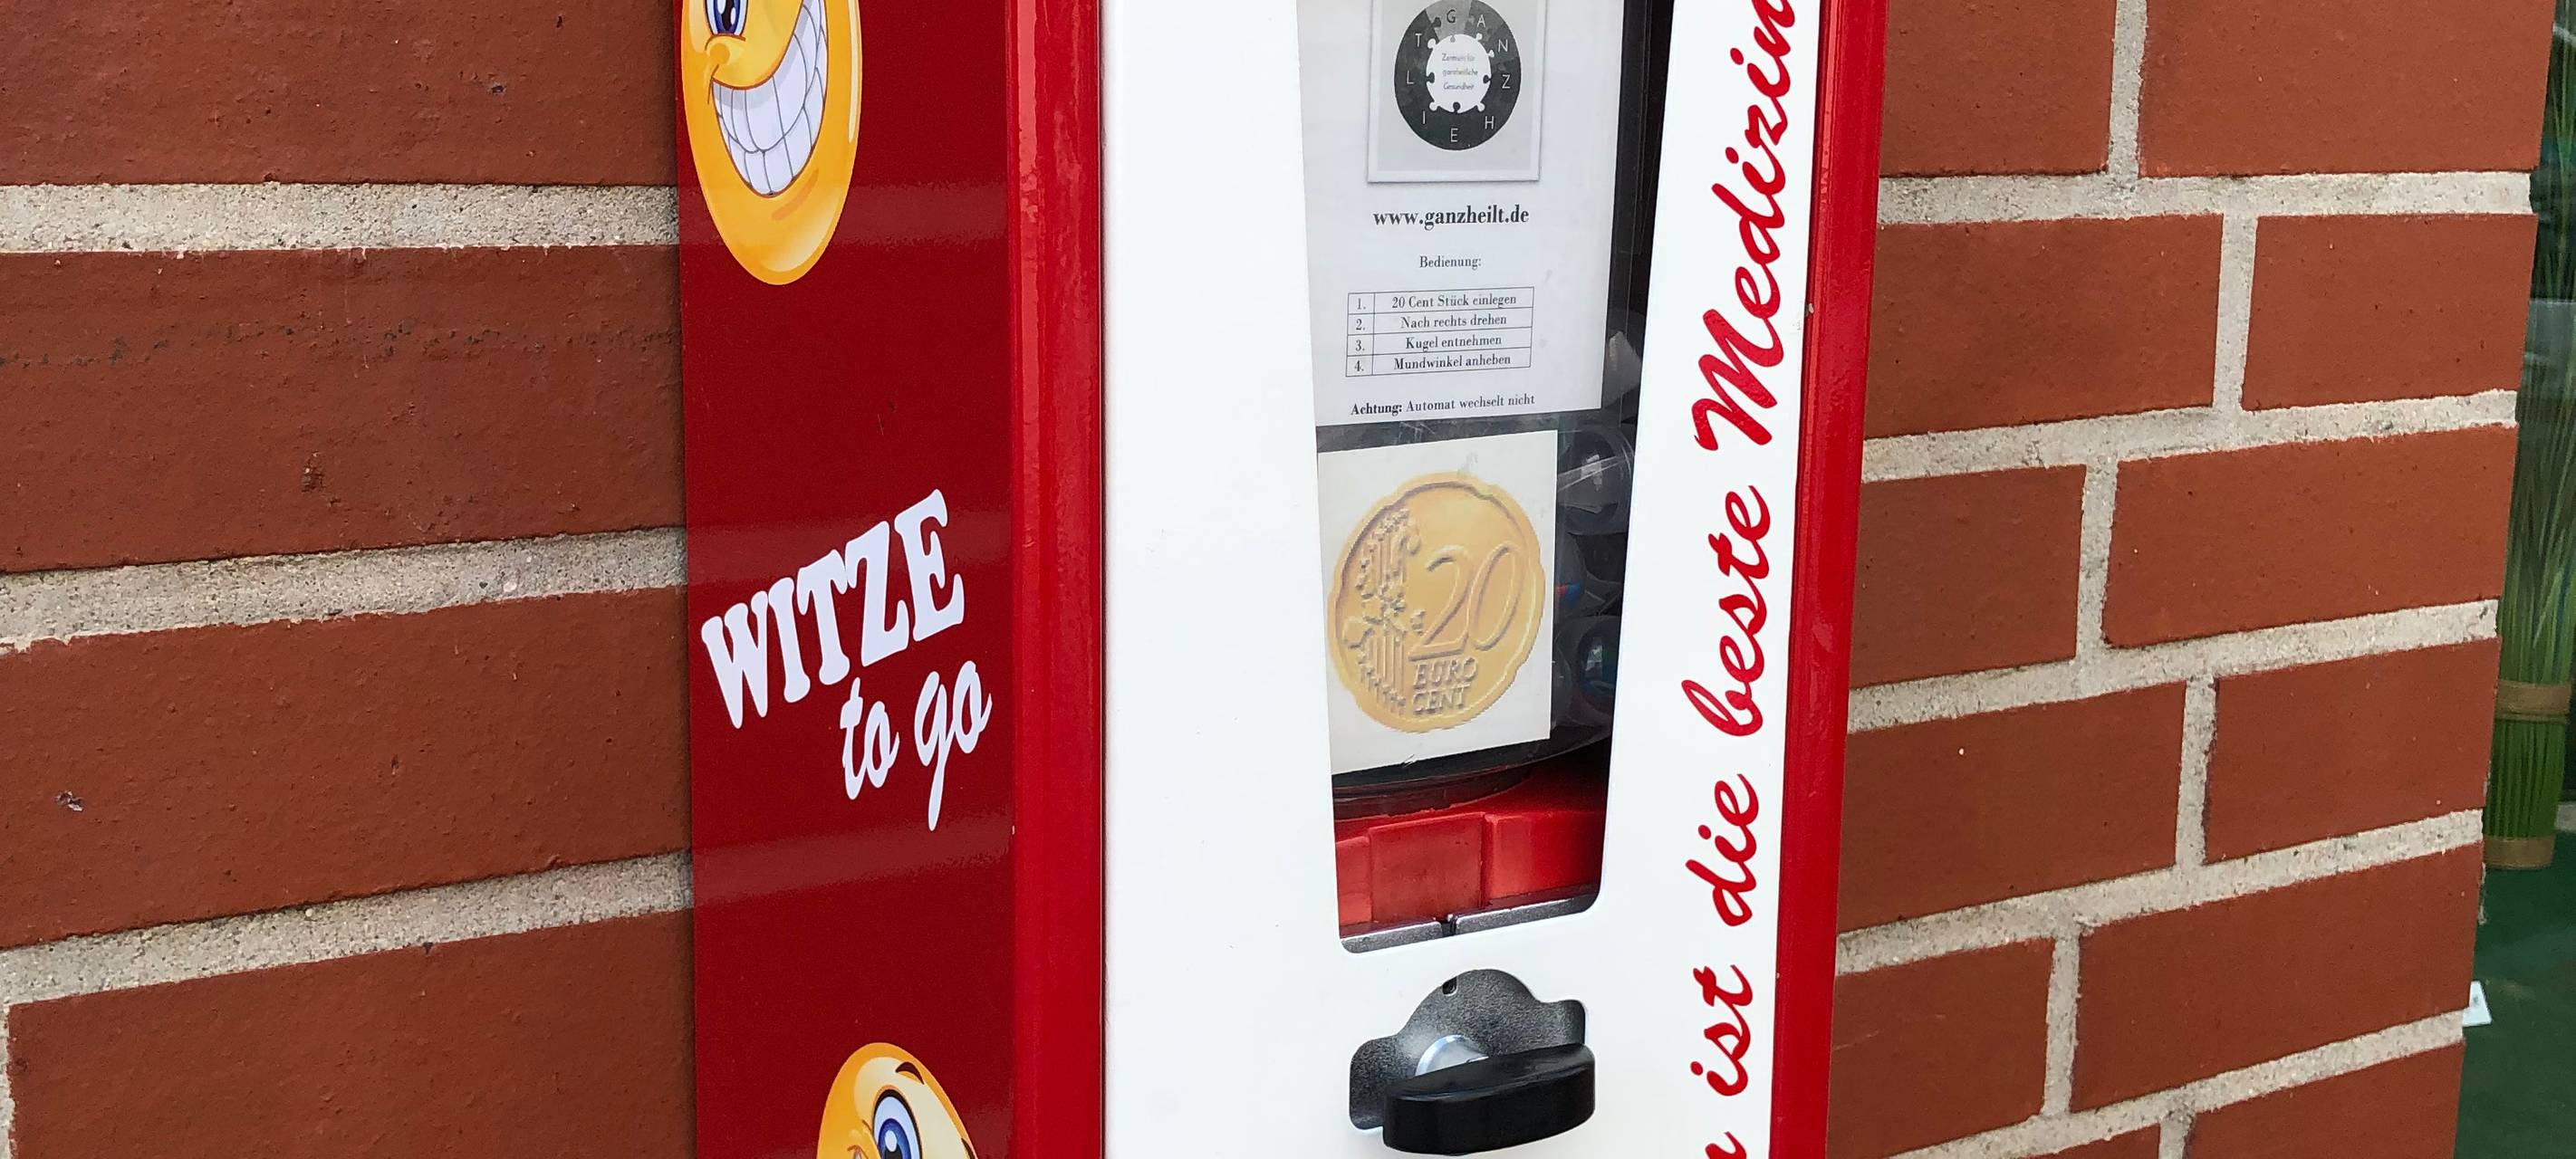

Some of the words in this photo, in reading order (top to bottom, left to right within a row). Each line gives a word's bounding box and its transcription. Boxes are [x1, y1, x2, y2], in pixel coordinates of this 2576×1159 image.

[1373, 204, 1530, 230] www.ganzheilt.de
[1691, 0, 1795, 451] Medizin
[1419, 255, 1482, 270] Bedienung:
[1357, 298, 1366, 310] 1.
[1391, 295, 1405, 309] 20
[1408, 294, 1435, 308] Cent
[1437, 293, 1469, 308] Stück
[1472, 292, 1517, 309] einlegen
[1356, 319, 1366, 330] 2.
[1400, 315, 1430, 329] Nach
[1433, 314, 1467, 328] rechts
[1470, 313, 1507, 326] drehen
[1355, 340, 1365, 351] 3.
[1406, 336, 1438, 352] Kugel
[1441, 335, 1502, 349] entnehmen
[1354, 359, 1364, 372] 4.
[1393, 355, 1463, 370] Mundwinkel
[1466, 353, 1511, 367] anheben
[1350, 401, 1403, 417] Achtung:
[1406, 398, 1456, 413] Automat
[1459, 395, 1504, 408] wechselt
[1508, 394, 1535, 407] nicht
[701, 489, 965, 729] WITZE
[1409, 541, 1522, 661] 20
[1681, 484, 1771, 736] beste
[1413, 656, 1477, 689] EURO
[1412, 683, 1470, 715] CENT
[840, 677, 900, 800] to
[915, 660, 993, 831] go
[1685, 773, 1759, 926] die
[1690, 964, 1753, 1097] ist
